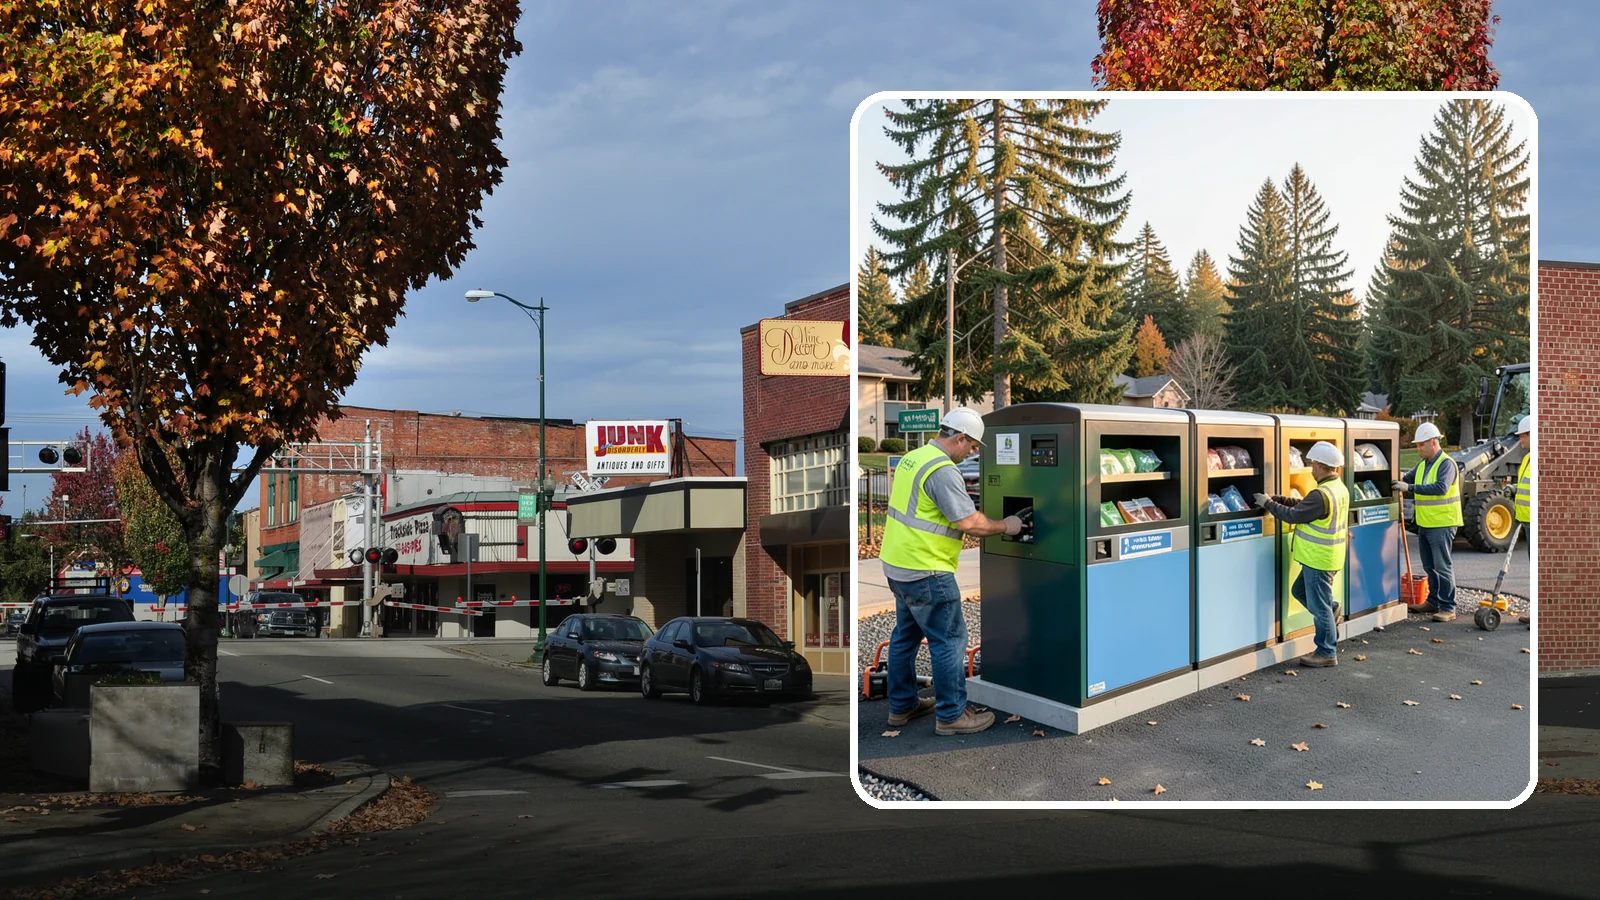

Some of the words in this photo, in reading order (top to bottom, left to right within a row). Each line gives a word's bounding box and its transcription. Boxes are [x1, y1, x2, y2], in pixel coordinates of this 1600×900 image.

[596, 425, 665, 457] JUNK
[597, 461, 628, 469] ANTIQUES
[631, 461, 643, 469] AND
[647, 461, 665, 469] GIFTS
[573, 473, 588, 490] RAIL
[415, 520, 429, 535] Pizza
